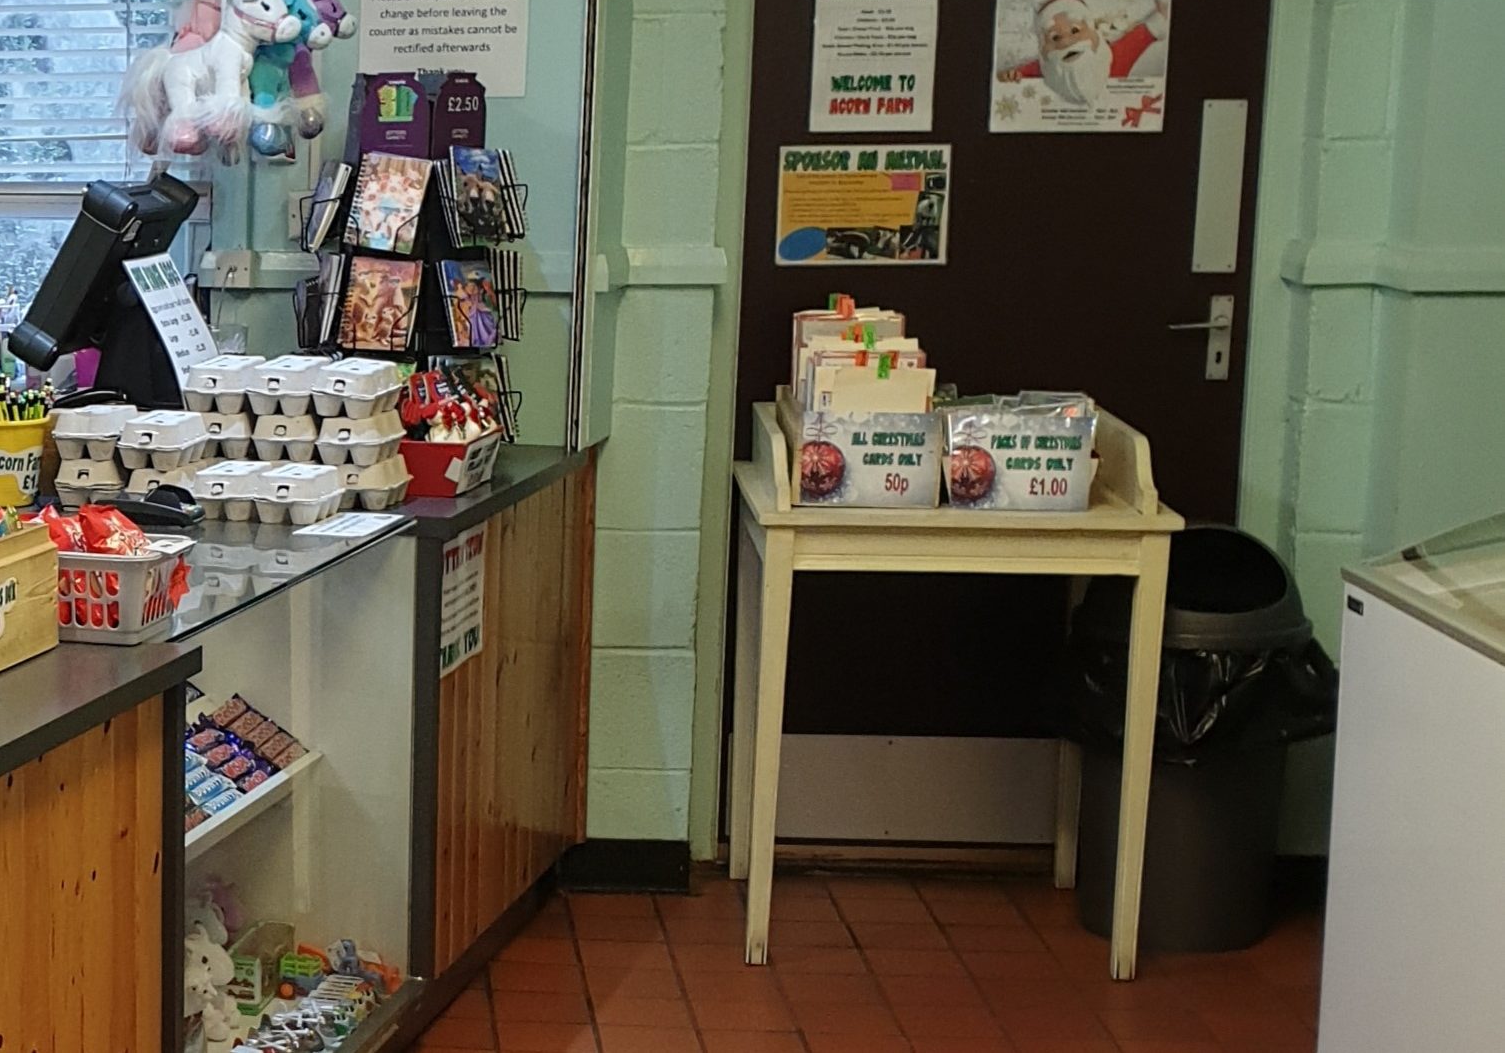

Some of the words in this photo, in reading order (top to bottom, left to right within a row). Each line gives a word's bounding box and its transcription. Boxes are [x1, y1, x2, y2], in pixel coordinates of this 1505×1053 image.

[379, 8, 415, 21] change
[416, 7, 449, 19] before
[451, 7, 488, 20] leaving
[489, 6, 507, 18] the
[368, 26, 407, 37] counter
[407, 27, 420, 37] as
[421, 24, 465, 36] mistakes
[467, 24, 502, 35] cannot
[503, 23, 518, 35] be
[393, 42, 434, 55] rectified
[436, 42, 491, 54] afterwards
[830, 74, 893, 93] WELCOME
[897, 73, 916, 92] TO
[447, 96, 480, 113] £2.50
[828, 97, 872, 115] ACORN
[876, 96, 915, 115] FARM
[783, 149, 851, 172] SPONSOR
[857, 149, 879, 171] AN
[884, 149, 948, 171] ANIMAL
[851, 432, 868, 446] ALL
[871, 431, 927, 447] CHRISTMAS
[990, 434, 1018, 450] PACKS
[1020, 434, 1032, 450] OF
[1034, 434, 1083, 451] CHRISTMAS
[862, 452, 895, 467] CARDS
[897, 452, 923, 467] ONLY
[1005, 457, 1042, 471] CARDS
[1045, 457, 1075, 471] ONLY
[884, 472, 910, 496] 50p
[1028, 476, 1068, 496] £1.00
[4, 580, 16, 605] BOX
